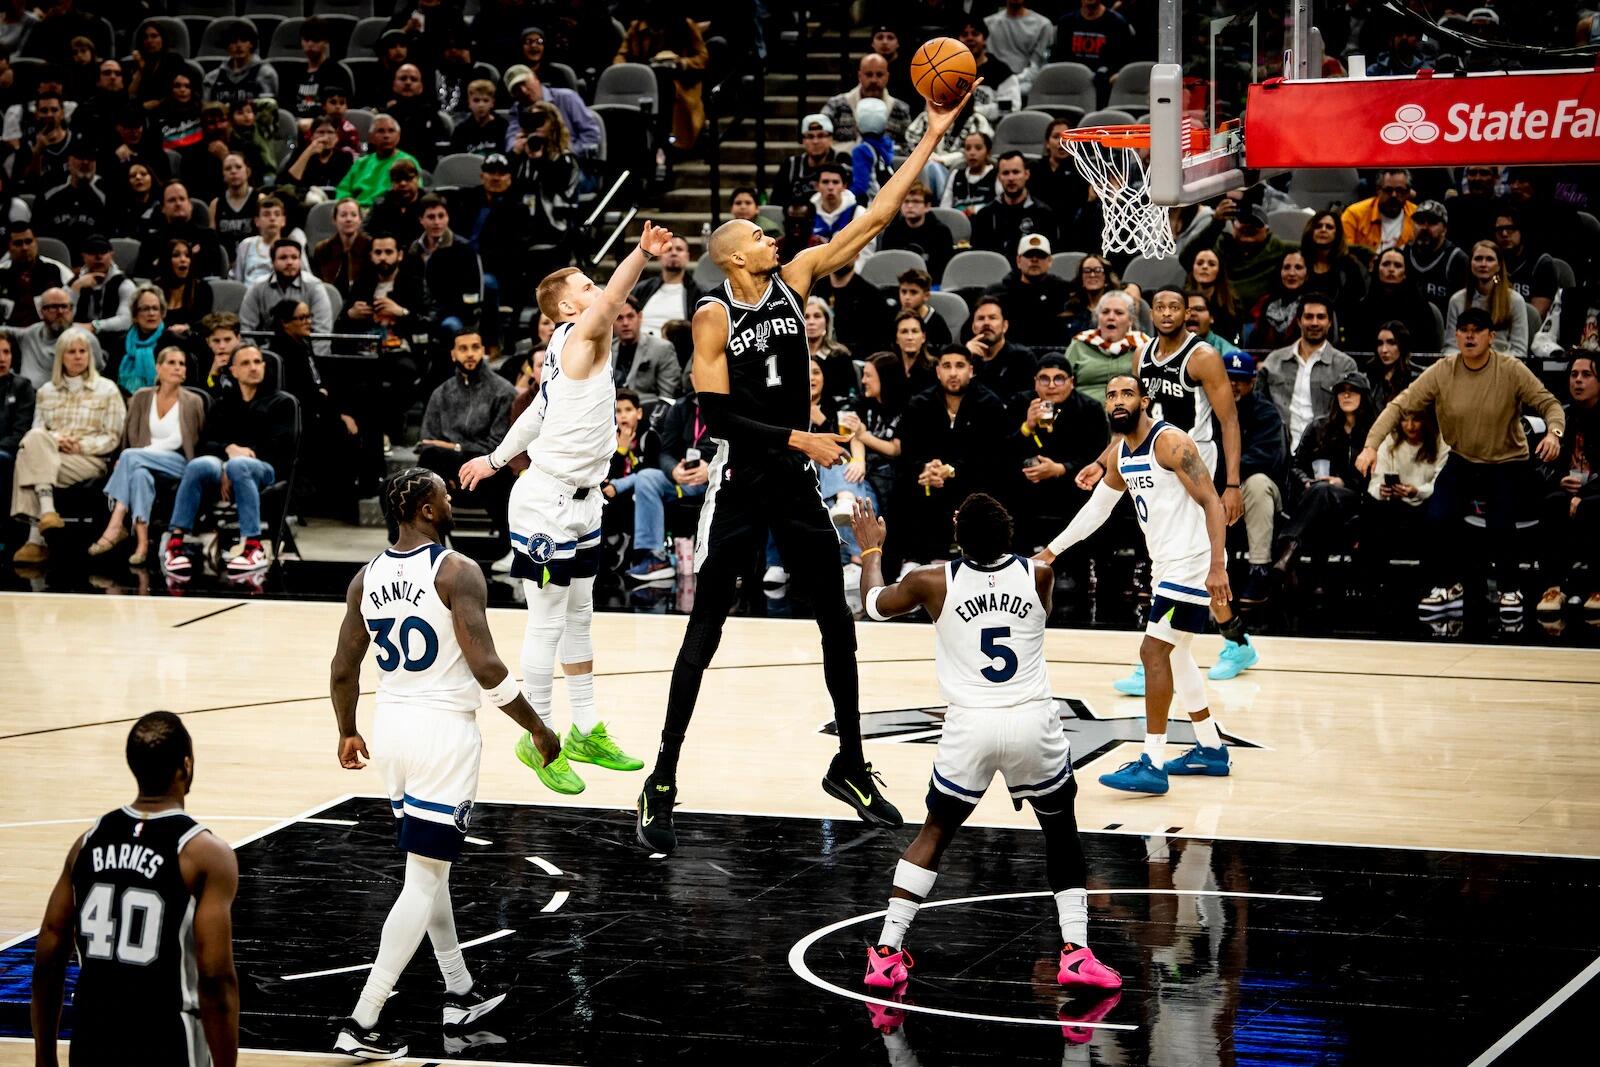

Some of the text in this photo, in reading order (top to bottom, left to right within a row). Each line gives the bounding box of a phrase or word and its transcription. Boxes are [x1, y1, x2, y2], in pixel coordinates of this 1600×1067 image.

[1443, 98, 1600, 143] State Fa
[765, 354, 782, 388] 1
[369, 580, 426, 610] RANDLE
[955, 592, 1033, 623] EDWARDS
[365, 615, 439, 672] 30
[980, 626, 1019, 683] 5
[92, 843, 164, 879] BARNES
[80, 882, 165, 966] 40
